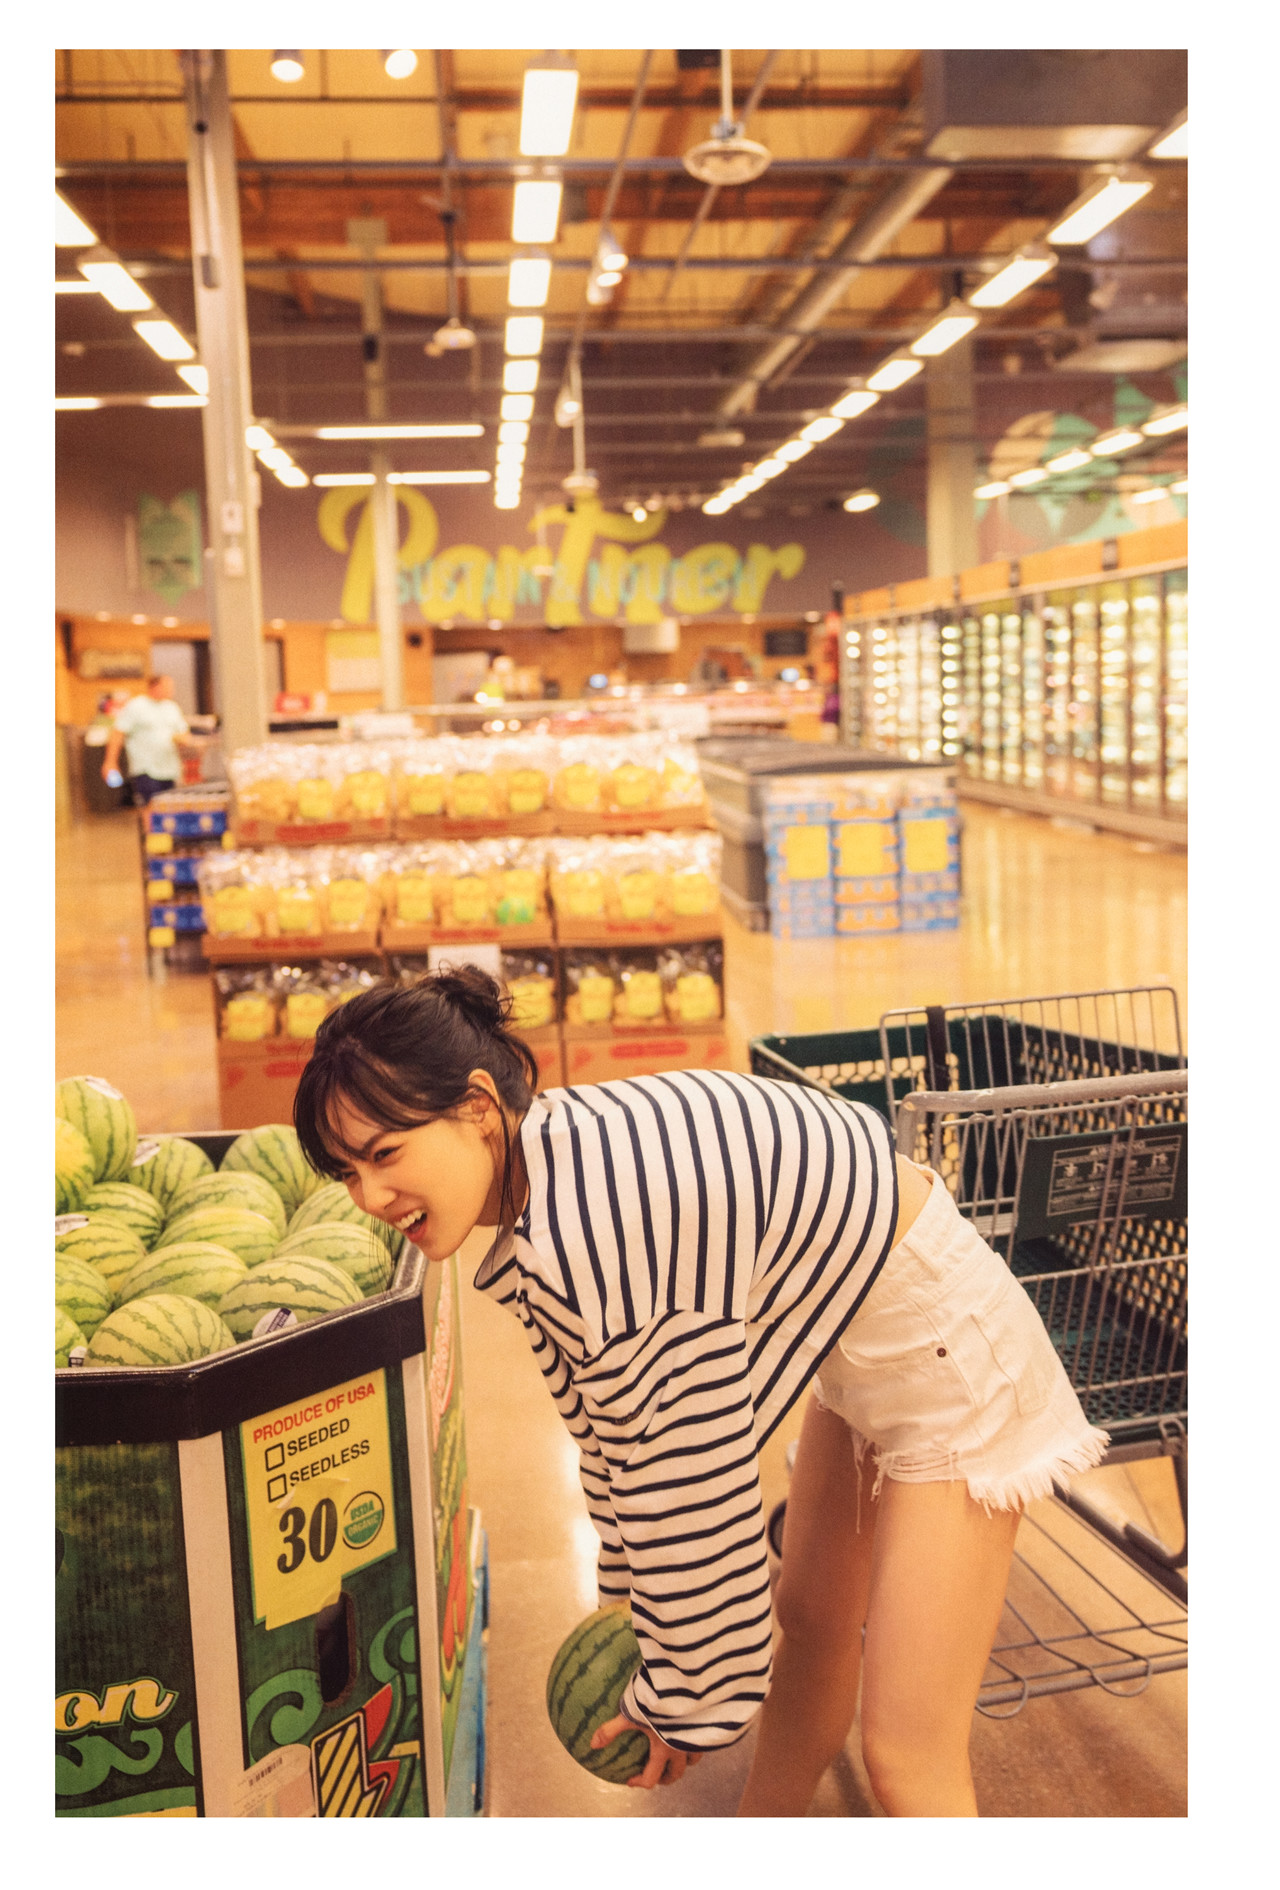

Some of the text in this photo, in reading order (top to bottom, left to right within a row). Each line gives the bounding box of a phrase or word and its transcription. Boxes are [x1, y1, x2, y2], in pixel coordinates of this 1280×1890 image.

[252, 1382, 376, 1444] PRODUCE OF USA
[287, 1418, 350, 1457] SEEDED
[290, 1439, 370, 1487] SEEDLESS
[277, 1497, 338, 1574] 30
